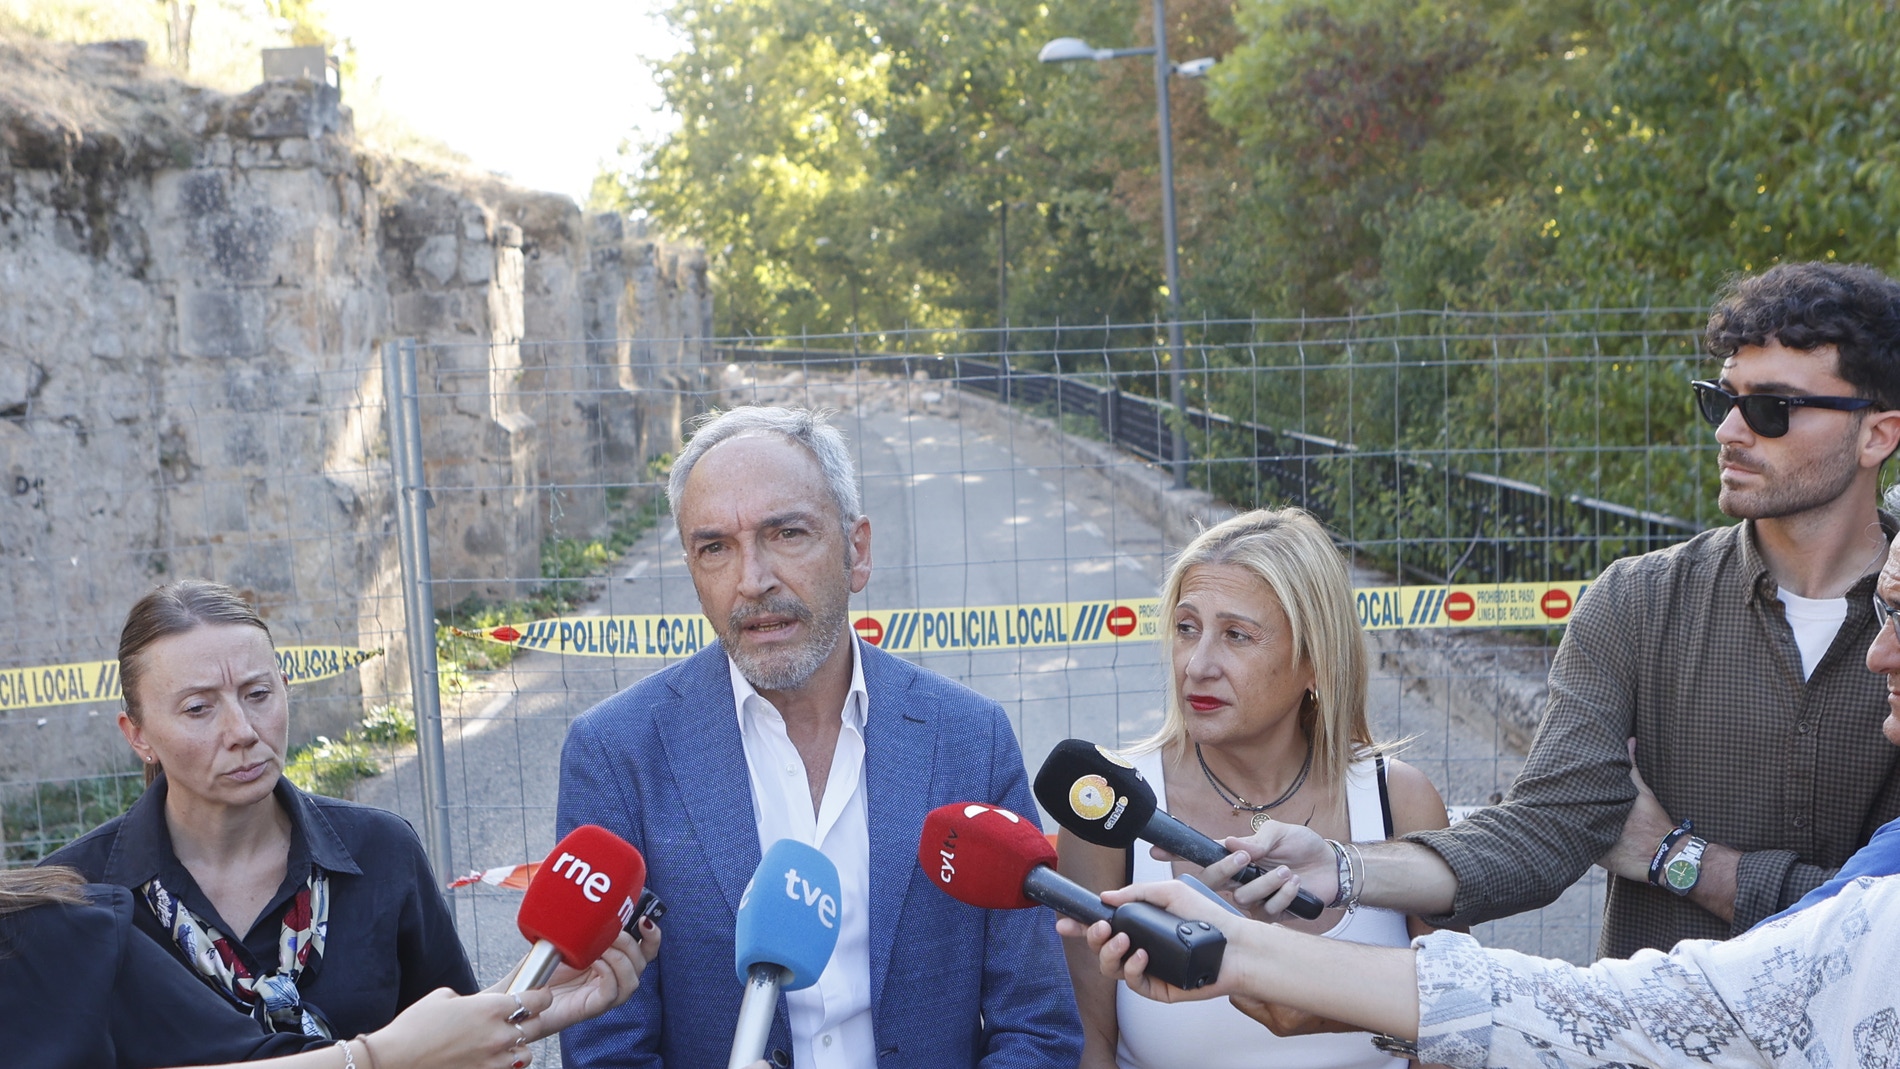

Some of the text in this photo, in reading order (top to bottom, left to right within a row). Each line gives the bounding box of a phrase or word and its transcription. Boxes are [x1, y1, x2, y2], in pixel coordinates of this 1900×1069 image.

[1477, 588, 1535, 605] PROHIBIDO EL PASO
[1477, 605, 1535, 622] LINEA DE POLICIA
[561, 617, 704, 655] POLICIA LOCAL
[923, 607, 1067, 648] POLICIA LOCAL
[33, 667, 90, 703] LOCAL
[552, 851, 611, 903] rne
[784, 868, 837, 929] tve
